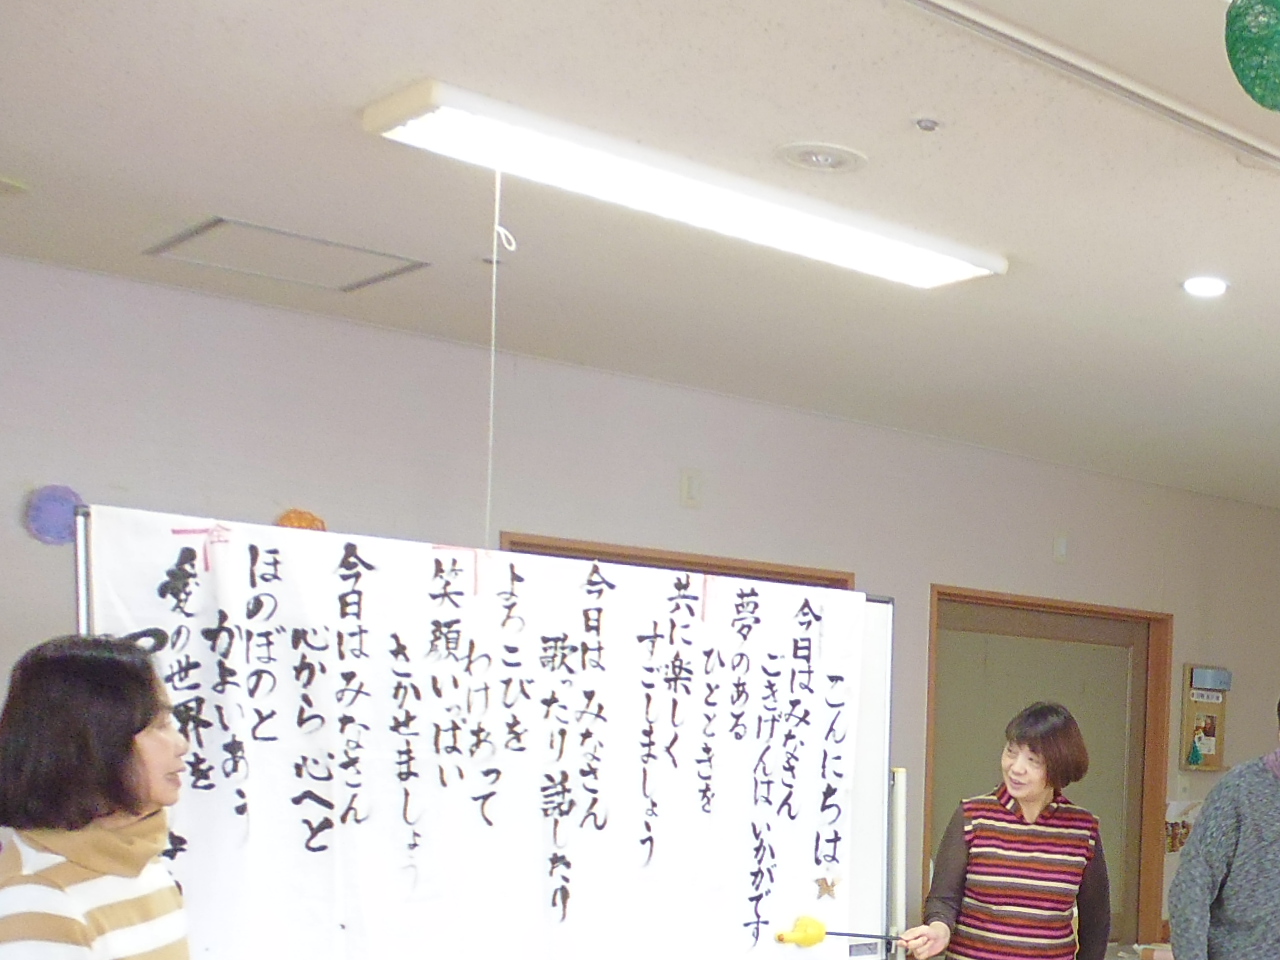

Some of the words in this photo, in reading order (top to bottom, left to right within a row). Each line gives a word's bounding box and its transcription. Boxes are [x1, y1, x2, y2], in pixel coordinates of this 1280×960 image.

[157, 546, 215, 790] 愛の世界を
[245, 544, 286, 742] ほのぼのと
[291, 625, 336, 852] 心から心へと
[335, 542, 375, 826] 今日はみなさん
[428, 558, 466, 787] 笑顔いっぱい
[463, 639, 503, 828] わけあって
[497, 563, 534, 752] よろこびを
[576, 562, 616, 831] 今日はみなさん
[636, 620, 665, 869] すごしましょう
[663, 574, 699, 770] 共に楽しく
[695, 646, 726, 814] ひとときを
[728, 587, 762, 741] 夢のある
[777, 597, 823, 822] 今日はみなさん
[743, 652, 786, 950] ごきげんはいかがです
[812, 674, 847, 868] こんにちは
